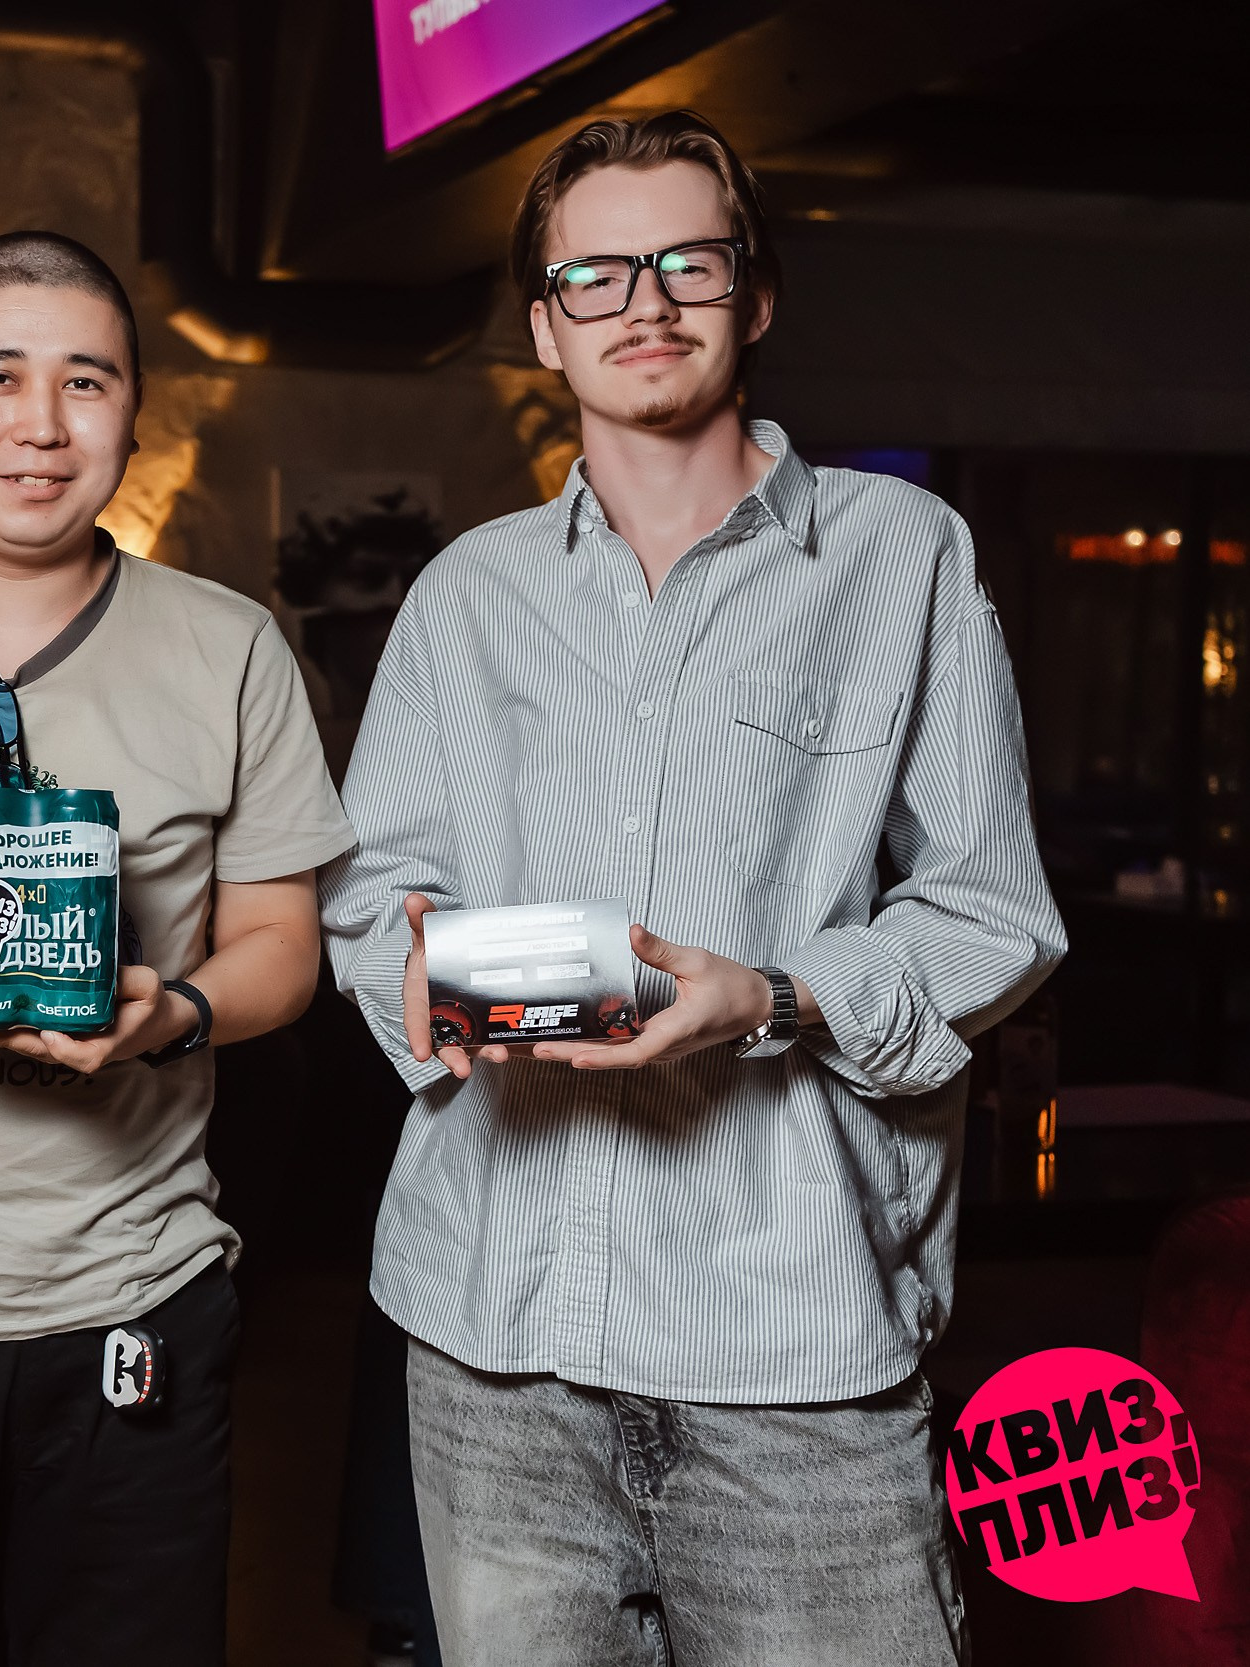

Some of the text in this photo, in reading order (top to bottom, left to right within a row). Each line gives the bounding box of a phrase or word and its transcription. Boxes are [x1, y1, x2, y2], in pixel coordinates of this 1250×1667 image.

[12, 904, 86, 940] ЛЫЙ
[36, 1003, 98, 1017] СВЕТЛОЕ
[519, 1017, 561, 1029] CLUB
